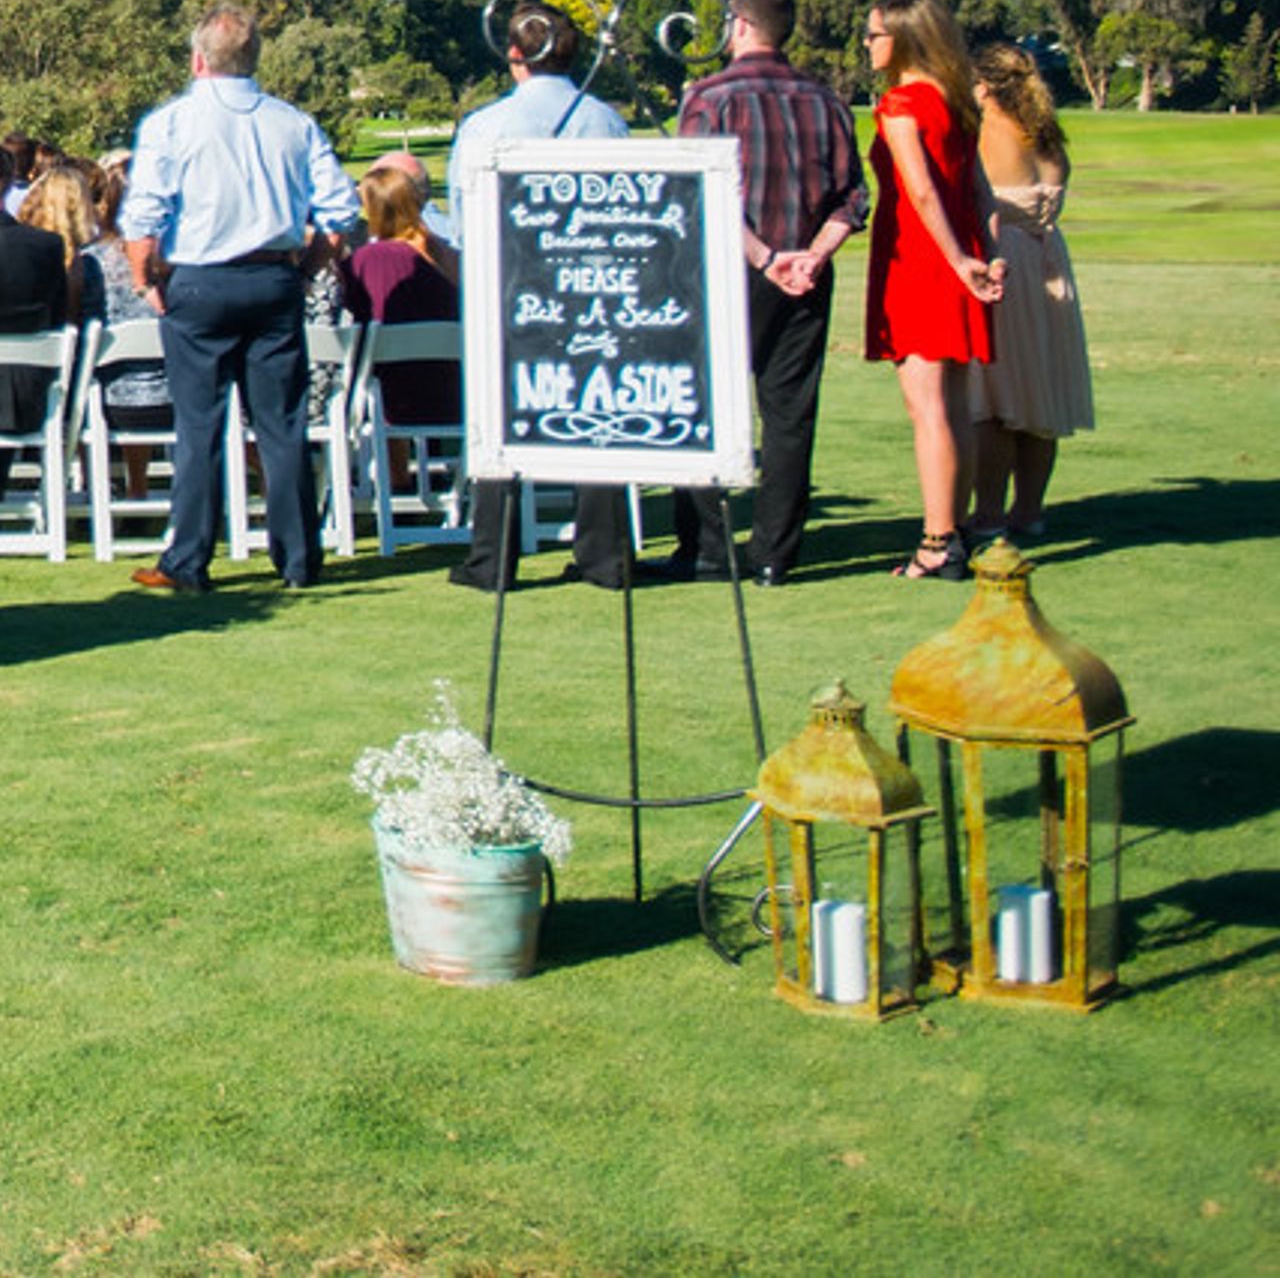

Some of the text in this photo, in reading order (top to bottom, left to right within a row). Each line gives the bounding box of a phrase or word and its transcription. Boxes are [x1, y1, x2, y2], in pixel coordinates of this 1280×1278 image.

[520, 173, 667, 203] TODAY
[509, 203, 559, 227] two
[557, 267, 639, 293] PLEASE
[514, 293, 690, 328] Pick A Seat
[580, 364, 615, 413] A
[615, 364, 699, 414] SIDE
